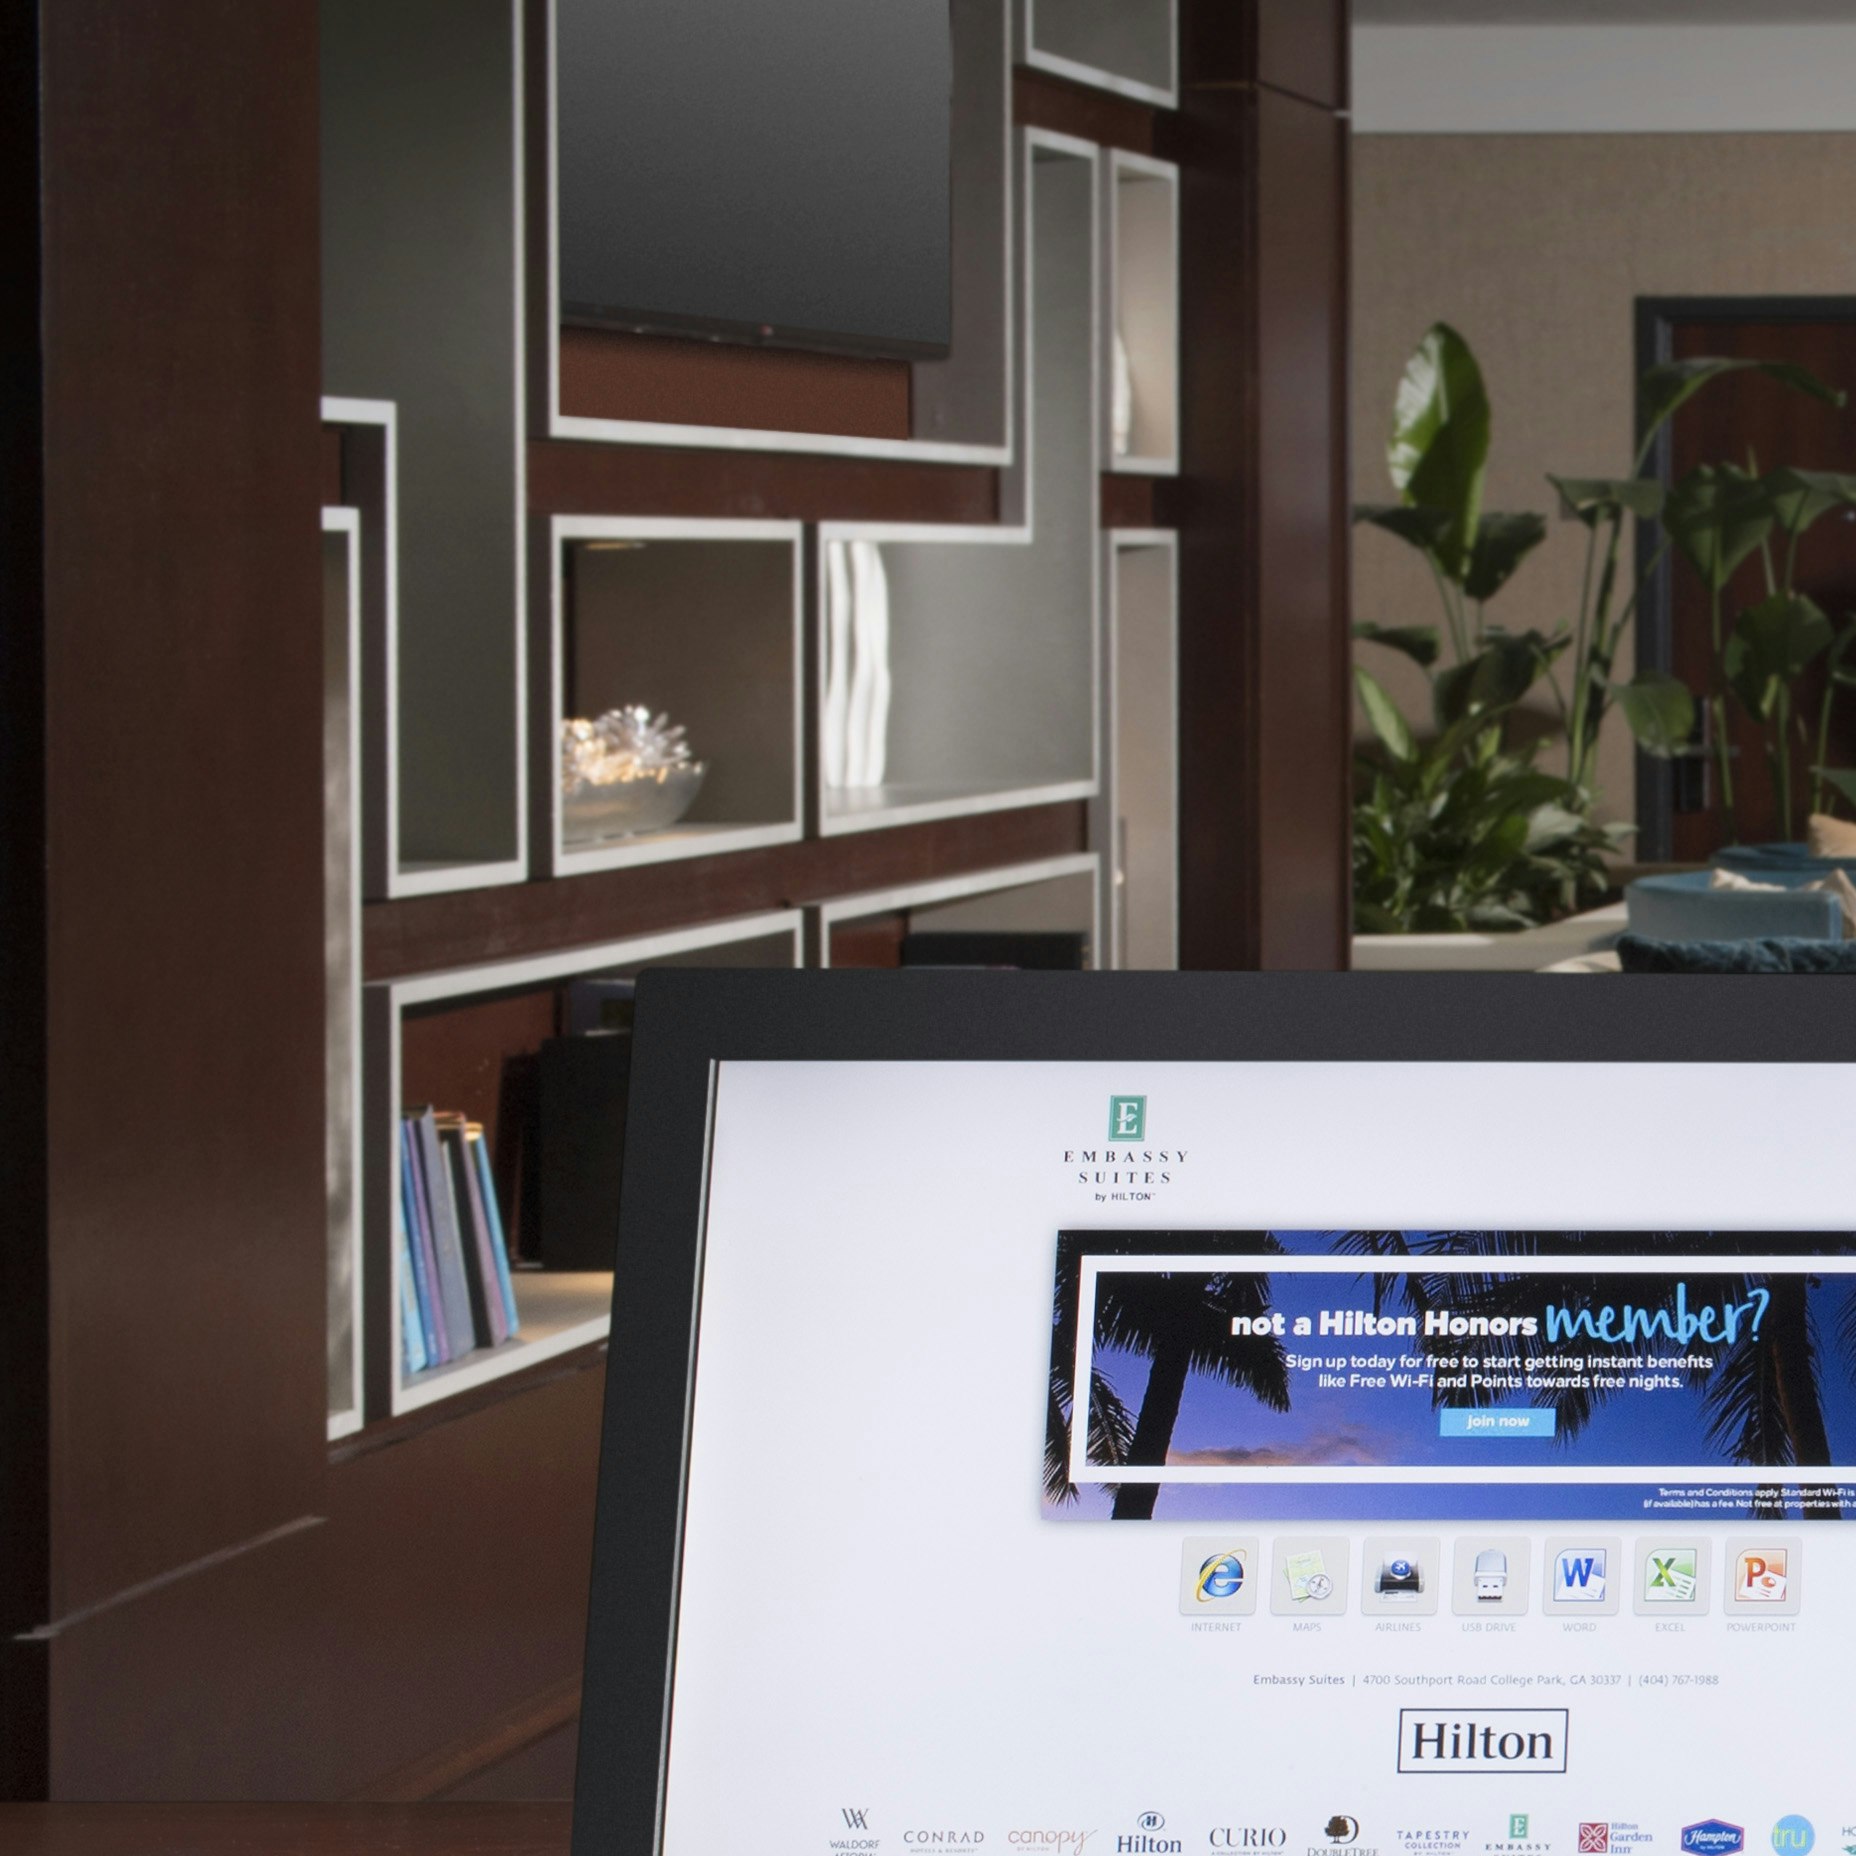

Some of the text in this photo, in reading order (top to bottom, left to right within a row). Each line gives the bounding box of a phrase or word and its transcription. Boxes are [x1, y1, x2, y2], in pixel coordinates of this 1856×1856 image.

[1064, 1151, 1188, 1162] EMBASSY
[1078, 1172, 1171, 1184] SUITES
[1095, 1192, 1107, 1202] by
[1231, 1282, 1770, 1344] not a Hilton Honors member?
[1285, 1354, 1713, 1371] Sign up today for free to start getting instant benefits
[1319, 1374, 1683, 1391] like Free Wi-Fi and Points towards free nights.
[1466, 1415, 1529, 1429] join now
[1659, 1488, 1685, 1496] Terms
[1687, 1488, 1704, 1496] and
[1706, 1488, 1752, 1496] Conditions
[1780, 1488, 1820, 1496] Standard
[1822, 1488, 1846, 1496] Wi-Fi
[1695, 1500, 1710, 1508] has
[1736, 1500, 1752, 1508] Not
[1754, 1500, 1772, 1508] free
[1774, 1500, 1782, 1508] at
[1784, 1500, 1830, 1508] properties
[1831, 1500, 1851, 1508] with
[1190, 1622, 1242, 1632] INTERNET
[1292, 1622, 1322, 1632] MAPS
[1375, 1622, 1422, 1632] AIRLINES
[1462, 1622, 1517, 1632] USB DRIVE
[1562, 1622, 1597, 1633] WORD
[1655, 1622, 1686, 1633] EXCEL
[1727, 1622, 1796, 1633] POWERPOINT
[1253, 1674, 1719, 1687] Embassy Suites 4700 Southport Road College Park, GA 30337 (404) 767-1988
[1411, 1722, 1554, 1760] Hilton
[903, 1831, 984, 1843] CONRAD
[1209, 1827, 1286, 1847] CURIO
[1397, 1831, 1470, 1840] TAPESTRY
[1609, 1832, 1653, 1842] Garden
[1774, 1824, 1807, 1848] tru
[829, 1840, 881, 1849] WALDORF
[1008, 1829, 1098, 1856] canopy
[1117, 1835, 1182, 1854] Hilton
